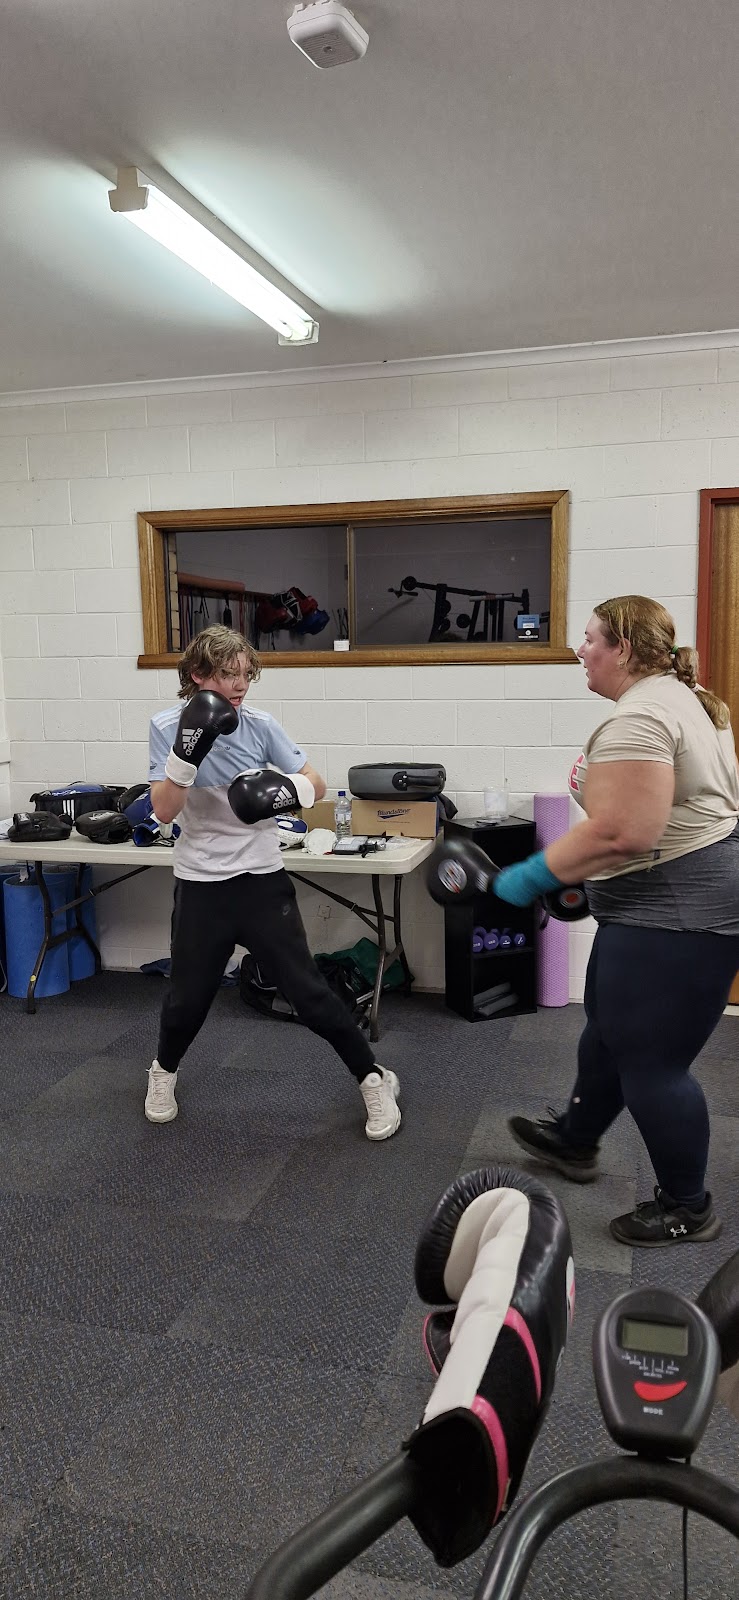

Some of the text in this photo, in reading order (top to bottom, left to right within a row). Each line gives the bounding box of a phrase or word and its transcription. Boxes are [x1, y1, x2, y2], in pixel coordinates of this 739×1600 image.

[185, 727, 204, 756] adidas
[272, 797, 296, 810] adidas
[643, 1406, 663, 1415] MODE
